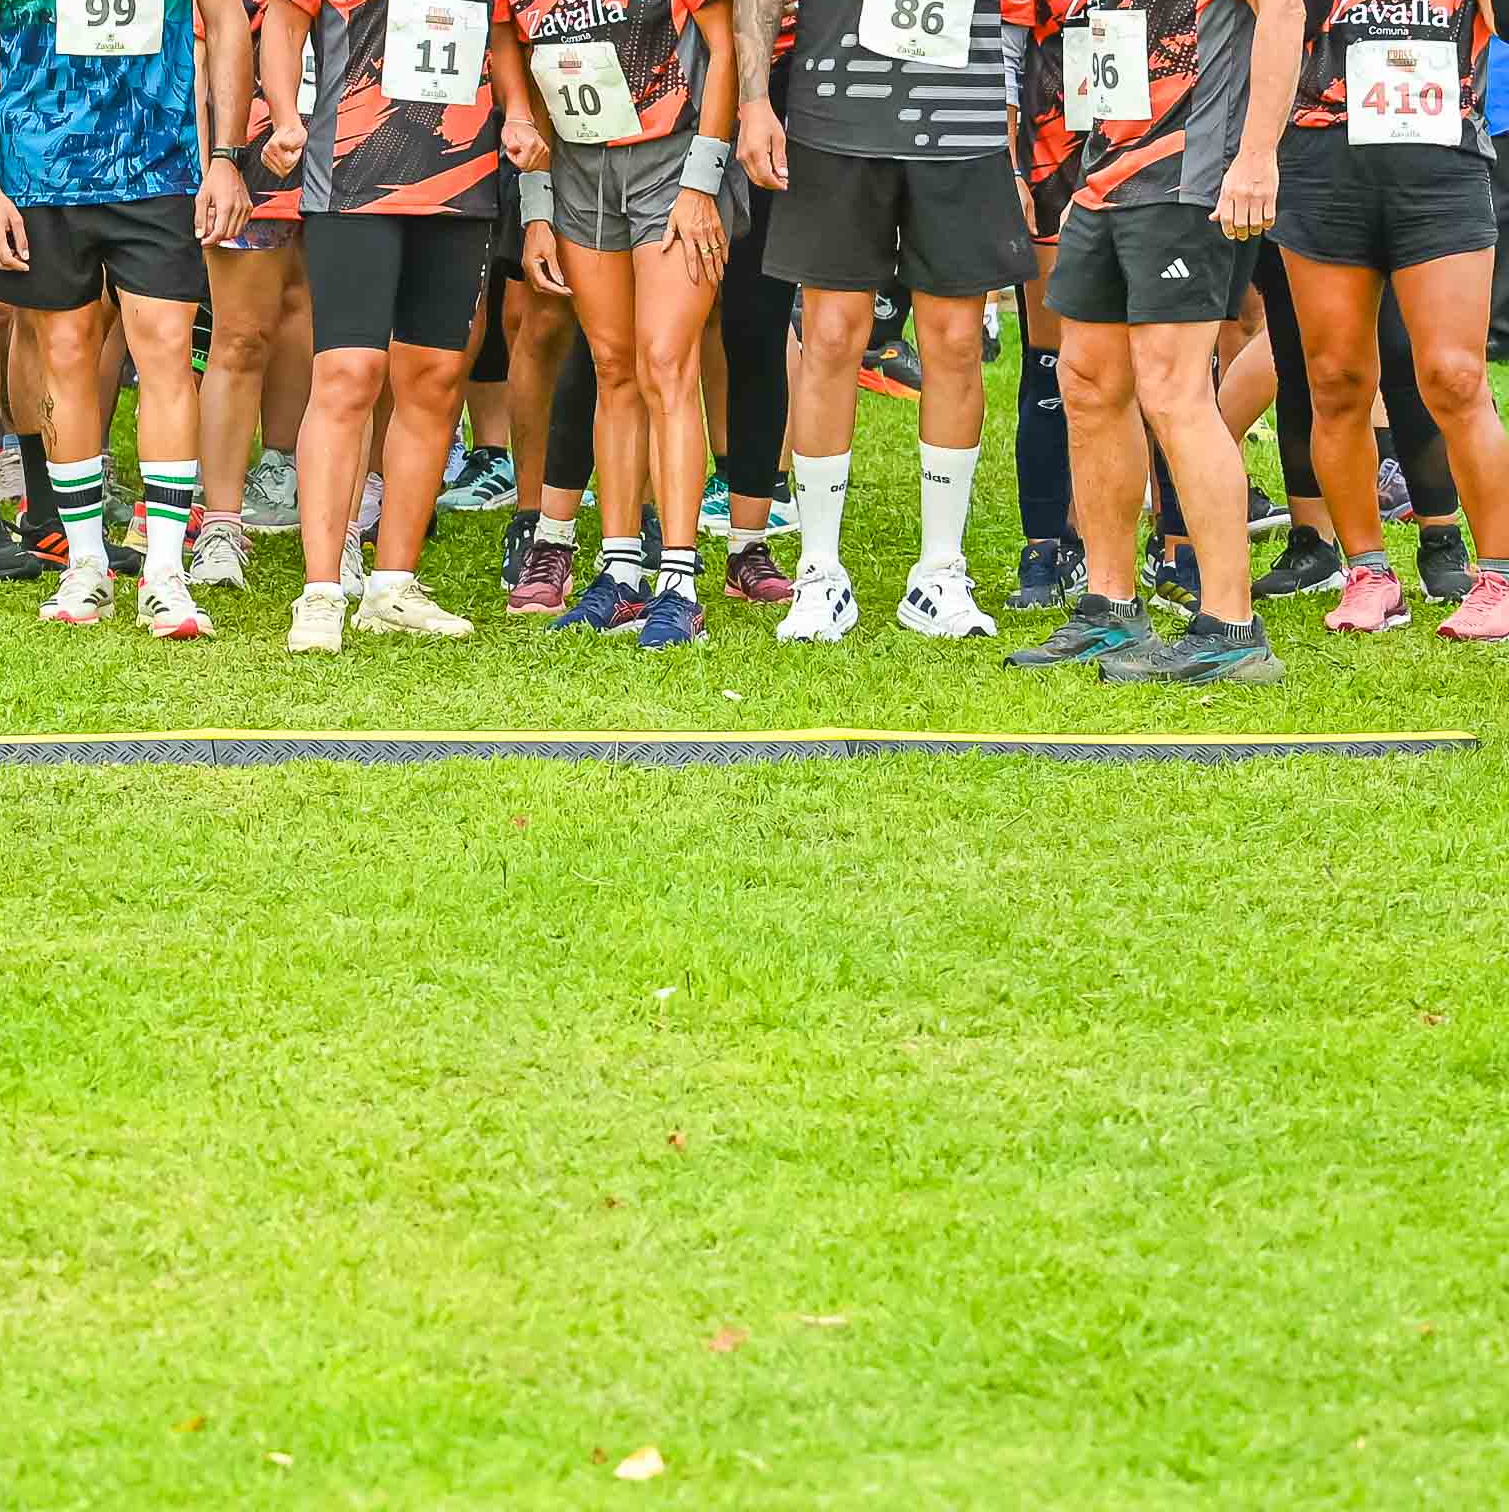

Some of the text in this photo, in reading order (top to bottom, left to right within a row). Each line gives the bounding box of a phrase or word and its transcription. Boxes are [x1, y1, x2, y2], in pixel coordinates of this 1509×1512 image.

[1368, 25, 1409, 36] Comuna
[414, 39, 459, 76] 11
[558, 83, 602, 116] 10
[1362, 81, 1444, 116] 410
